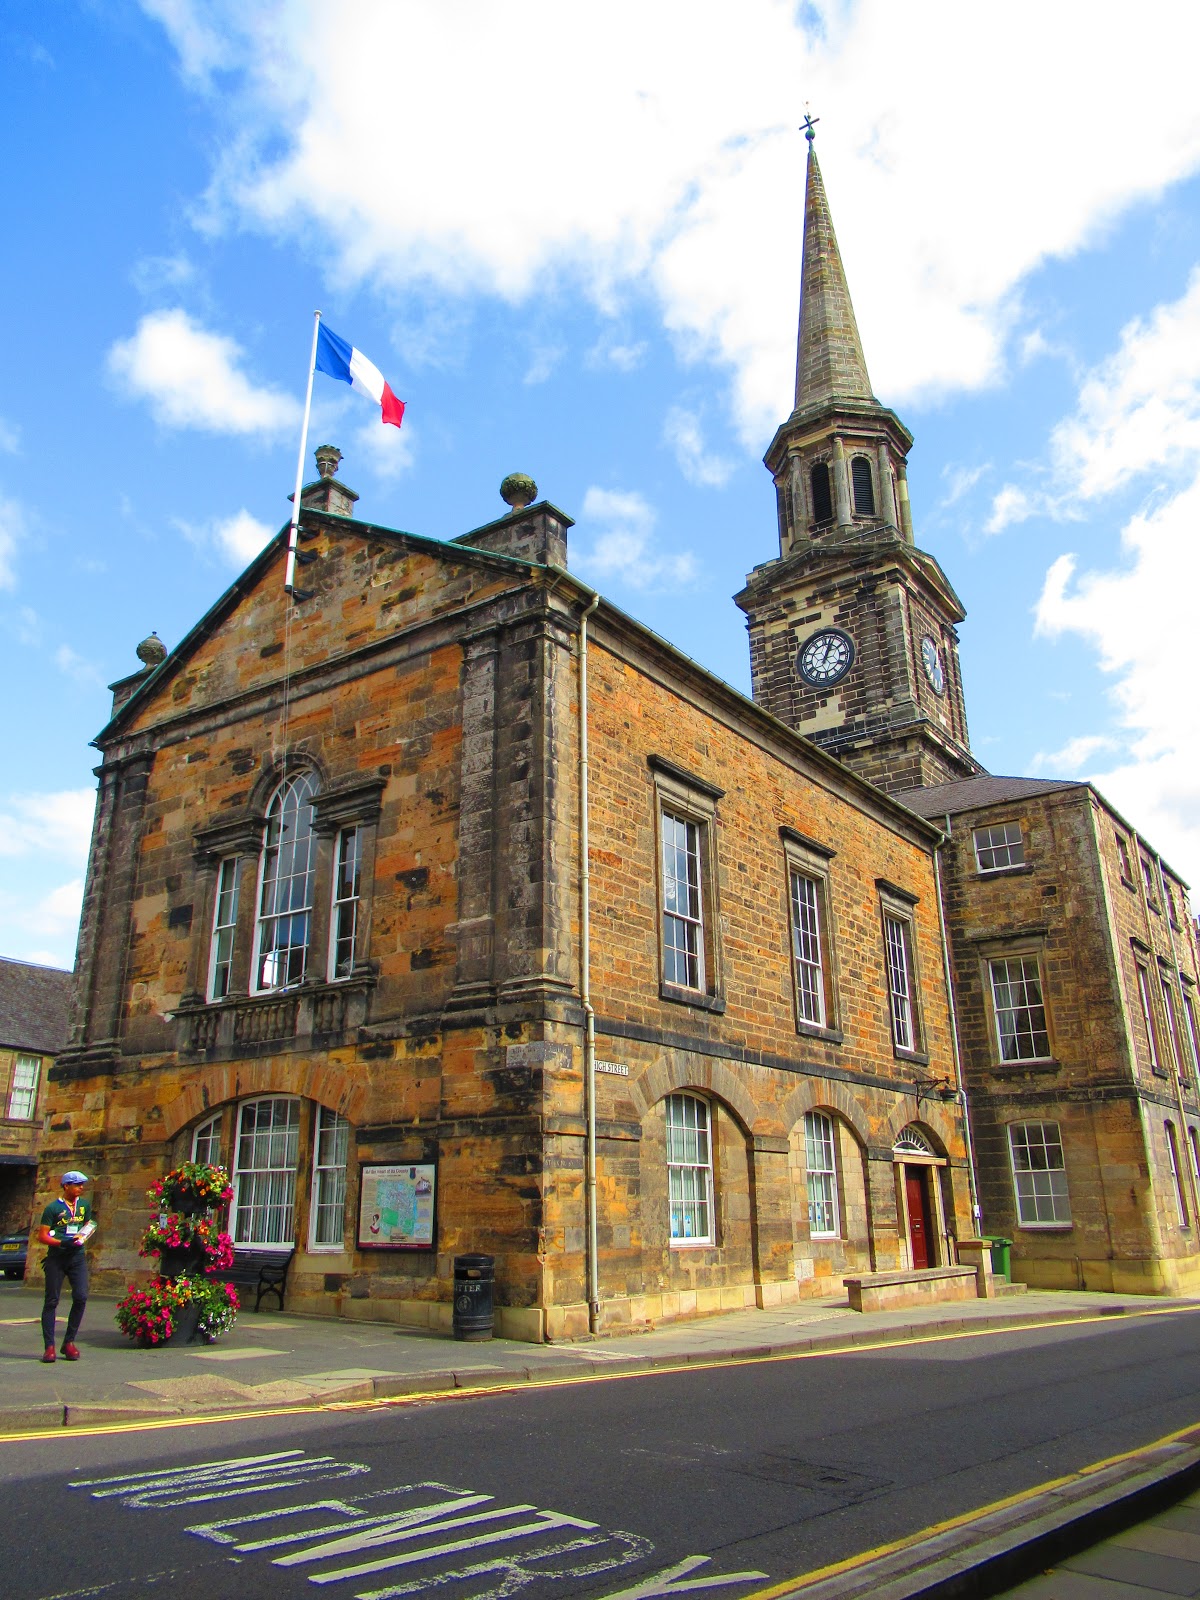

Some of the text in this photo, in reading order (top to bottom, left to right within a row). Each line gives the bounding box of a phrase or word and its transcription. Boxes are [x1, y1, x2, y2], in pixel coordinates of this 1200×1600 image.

[607, 1063, 627, 1075] STREET
[68, 1449, 770, 1600] NO ENTRY
